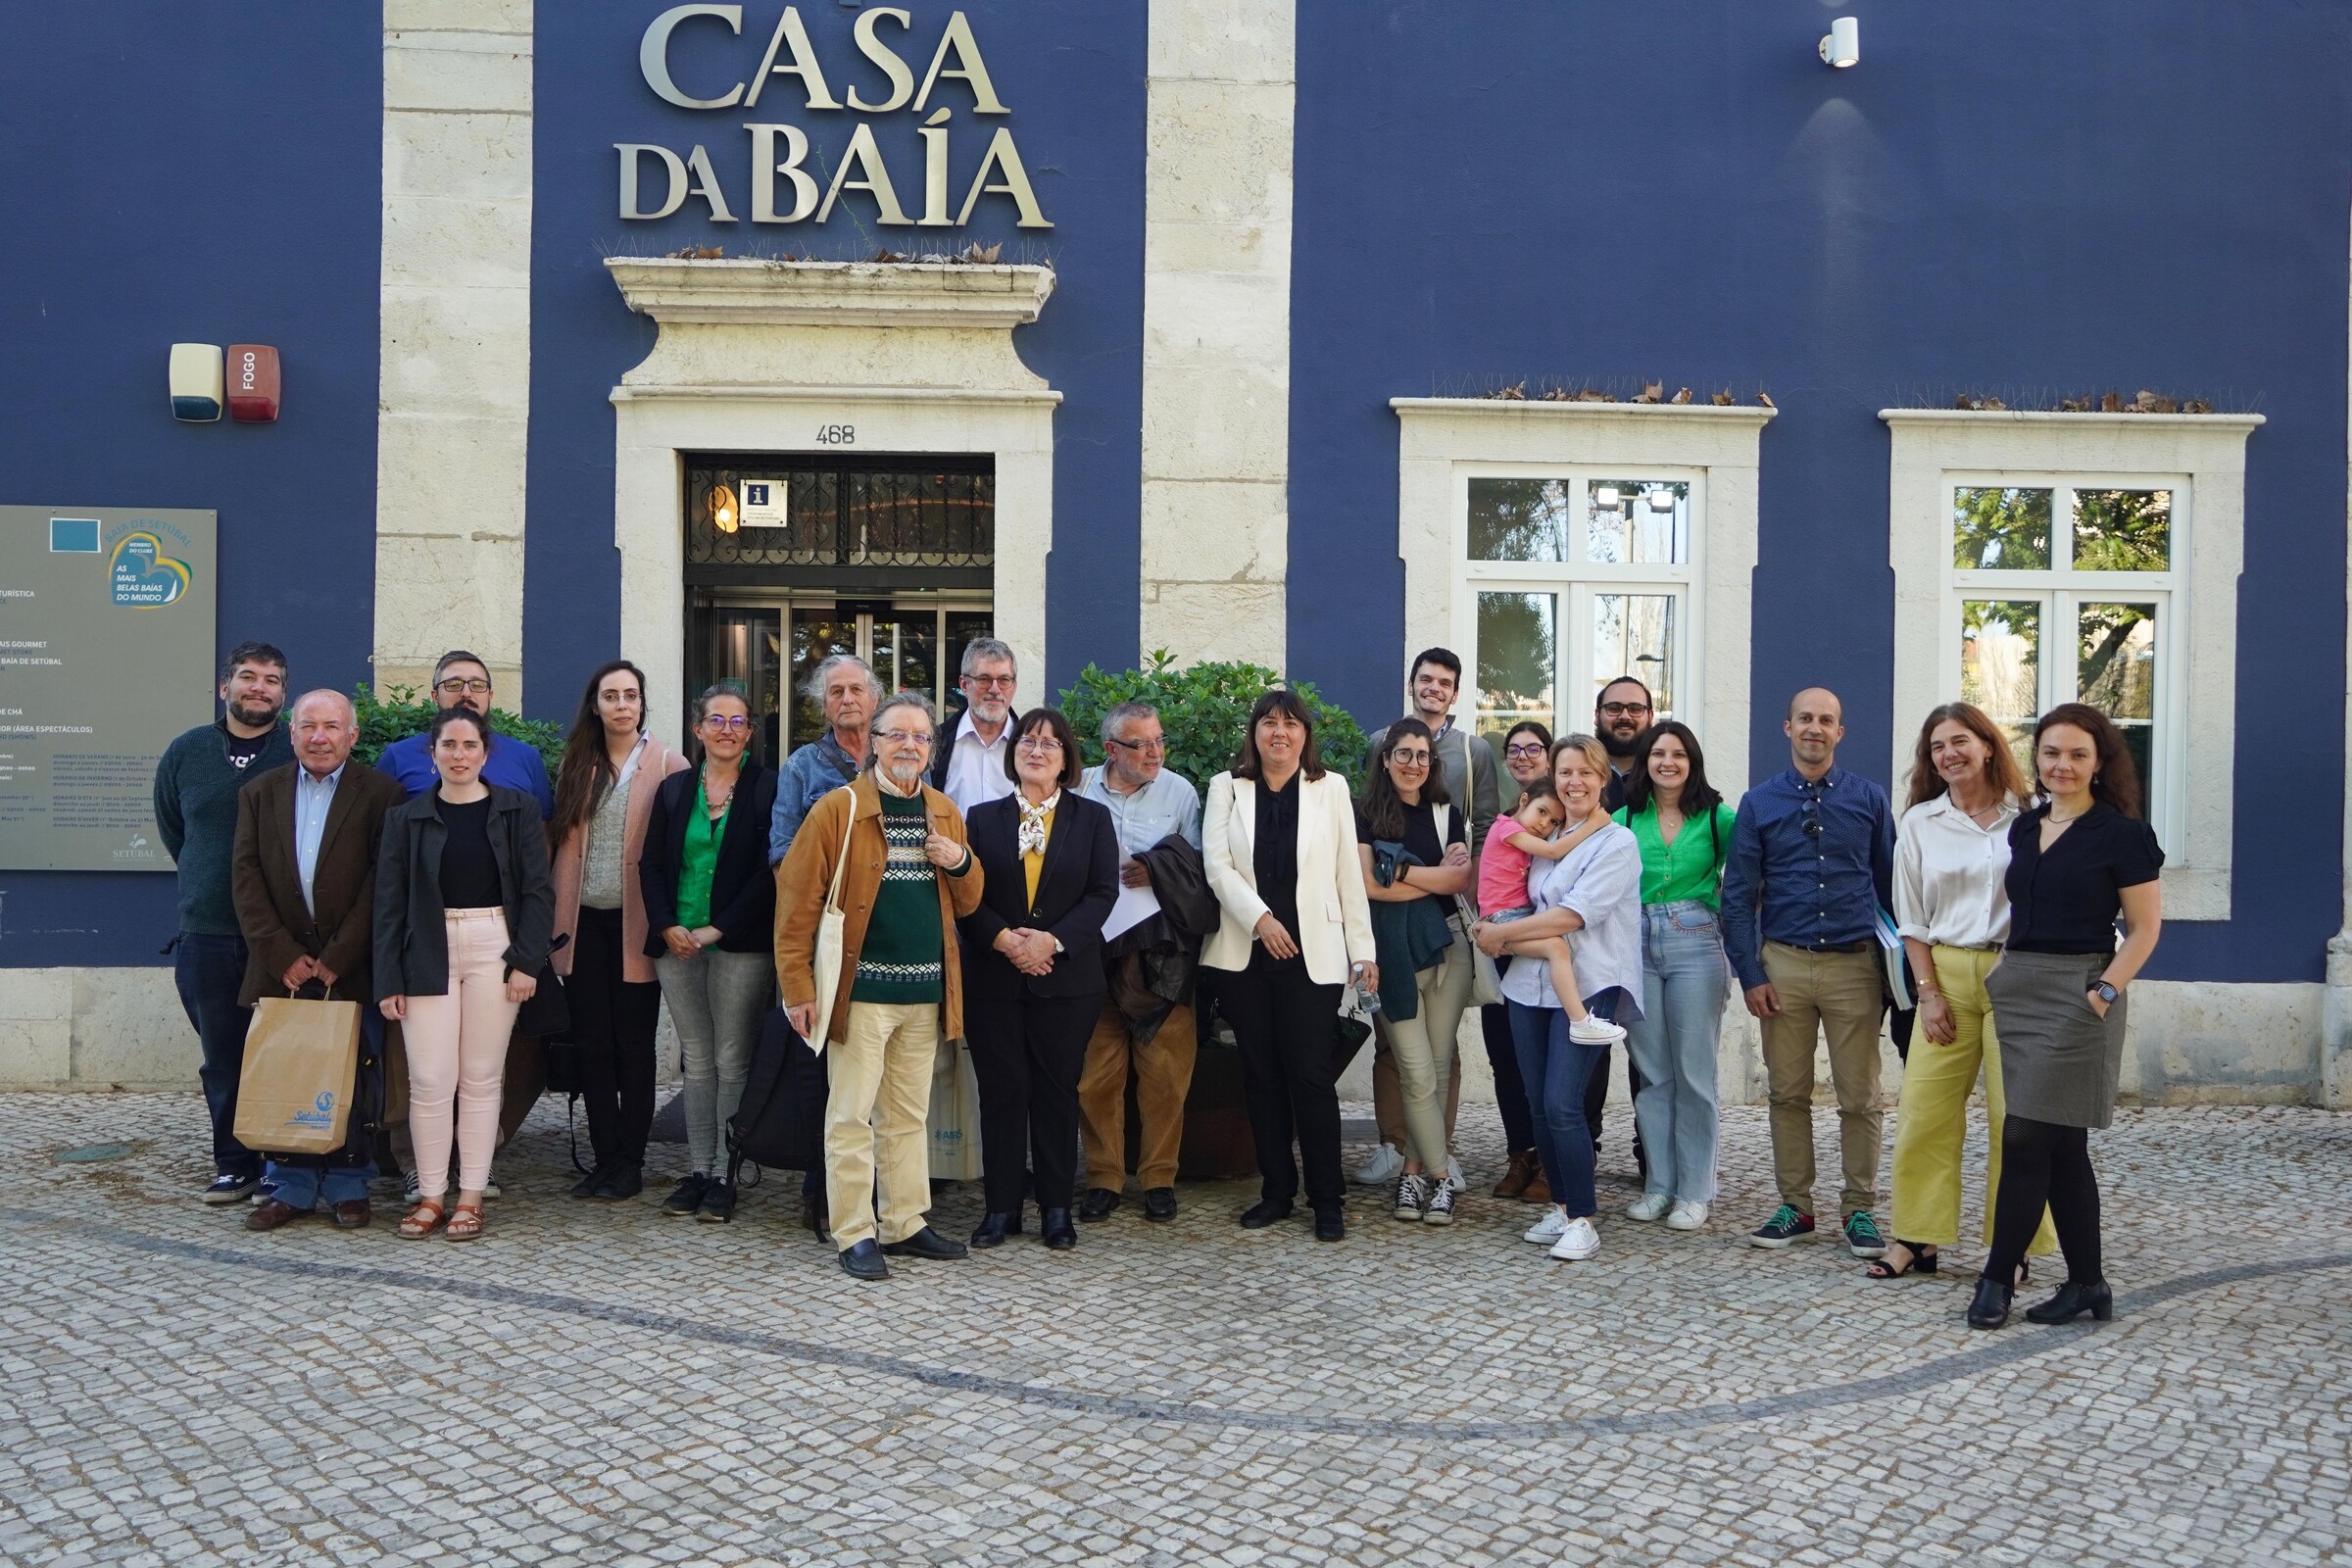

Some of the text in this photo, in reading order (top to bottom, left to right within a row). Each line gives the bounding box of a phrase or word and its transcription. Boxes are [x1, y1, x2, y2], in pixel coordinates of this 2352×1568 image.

[639, 4, 1011, 114] CASA
[612, 107, 1055, 228] DA BAÍA
[243, 352, 255, 390] FOGO
[815, 424, 856, 445] 468
[130, 518, 146, 528] DE
[140, 582, 163, 592] BAÍAS
[30, 657, 63, 665] SETÚBAL
[35, 725, 93, 734] ESPECTÁCULOS)
